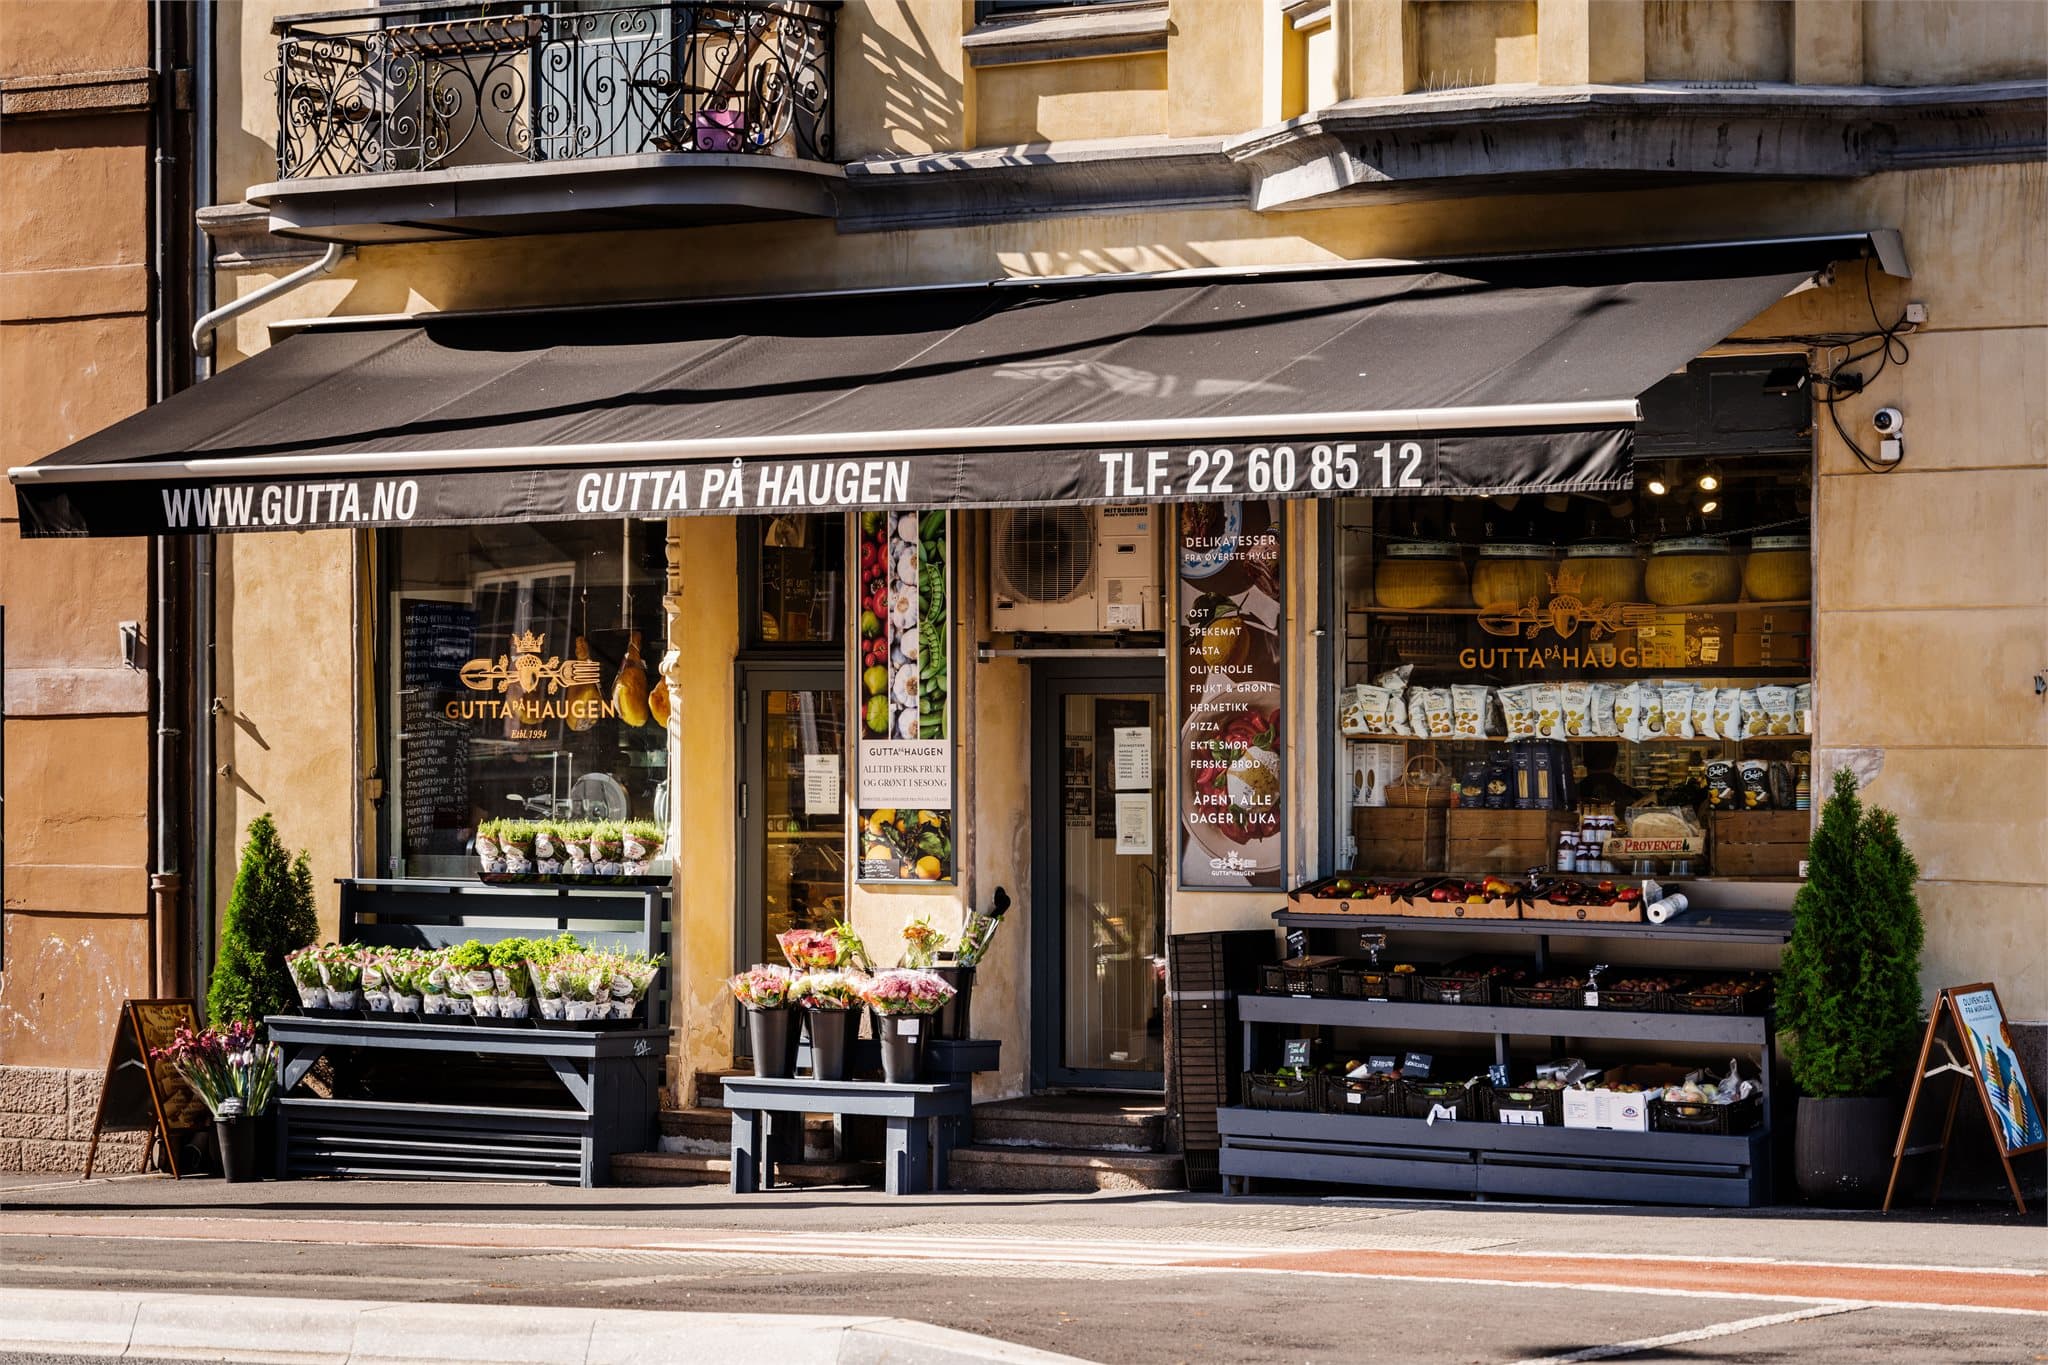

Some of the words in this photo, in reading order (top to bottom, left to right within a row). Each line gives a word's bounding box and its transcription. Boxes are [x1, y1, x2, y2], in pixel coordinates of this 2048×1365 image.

[1100, 452, 1172, 498] TLF.
[1186, 449, 1234, 494] 22
[1248, 446, 1295, 491] 60
[1310, 443, 1359, 490] 85
[1373, 441, 1423, 488] 12
[576, 470, 688, 514] GUTTA
[701, 457, 746, 508] PÅ
[757, 460, 910, 506] HAUGEN
[162, 480, 419, 528] WWW.GUTTA.NO
[1186, 535, 1276, 548] DELIKATESSER
[1185, 553, 1201, 561] FRA
[1204, 552, 1246, 561] ØVERSTE
[1248, 551, 1277, 560] HYLLE
[1189, 608, 1209, 618] OST
[1189, 627, 1242, 637] SPEKEMAT
[1189, 646, 1220, 656] PASTA
[1458, 647, 1545, 670] GUTTA
[1544, 644, 1562, 660] PÅ
[1562, 647, 1677, 669] HAUGEN
[1189, 665, 1253, 674] OLIVENOLJE
[1190, 684, 1222, 693] FRUKT
[1237, 683, 1274, 693] GRØNT
[445, 700, 513, 719] GUTTA
[512, 697, 526, 711] PÅ
[526, 700, 615, 719] HAUGEN
[1190, 703, 1249, 712] HERMETIKK
[1190, 722, 1220, 732] PIZZA
[1190, 741, 1215, 751] EKTE
[1219, 740, 1249, 751] SMØR
[869, 748, 899, 756] GUTTA
[904, 748, 943, 756] HAUGEN
[864, 765, 892, 773] ALLTID
[893, 765, 919, 773] FERSK
[920, 765, 946, 773] FRUKT
[1190, 760, 1228, 770] FERSKE
[1231, 760, 1261, 769] BRØD
[864, 779, 876, 787] OG
[878, 779, 906, 787] GRØNT
[914, 779, 947, 787] SESONG
[1193, 791, 1236, 806] ÅPENT
[1240, 794, 1272, 806] ALLE
[1190, 812, 1234, 825] DAGER
[1239, 812, 1243, 824] I
[1249, 812, 1277, 824] UKA
[1625, 839, 1683, 853] PROVENCE
